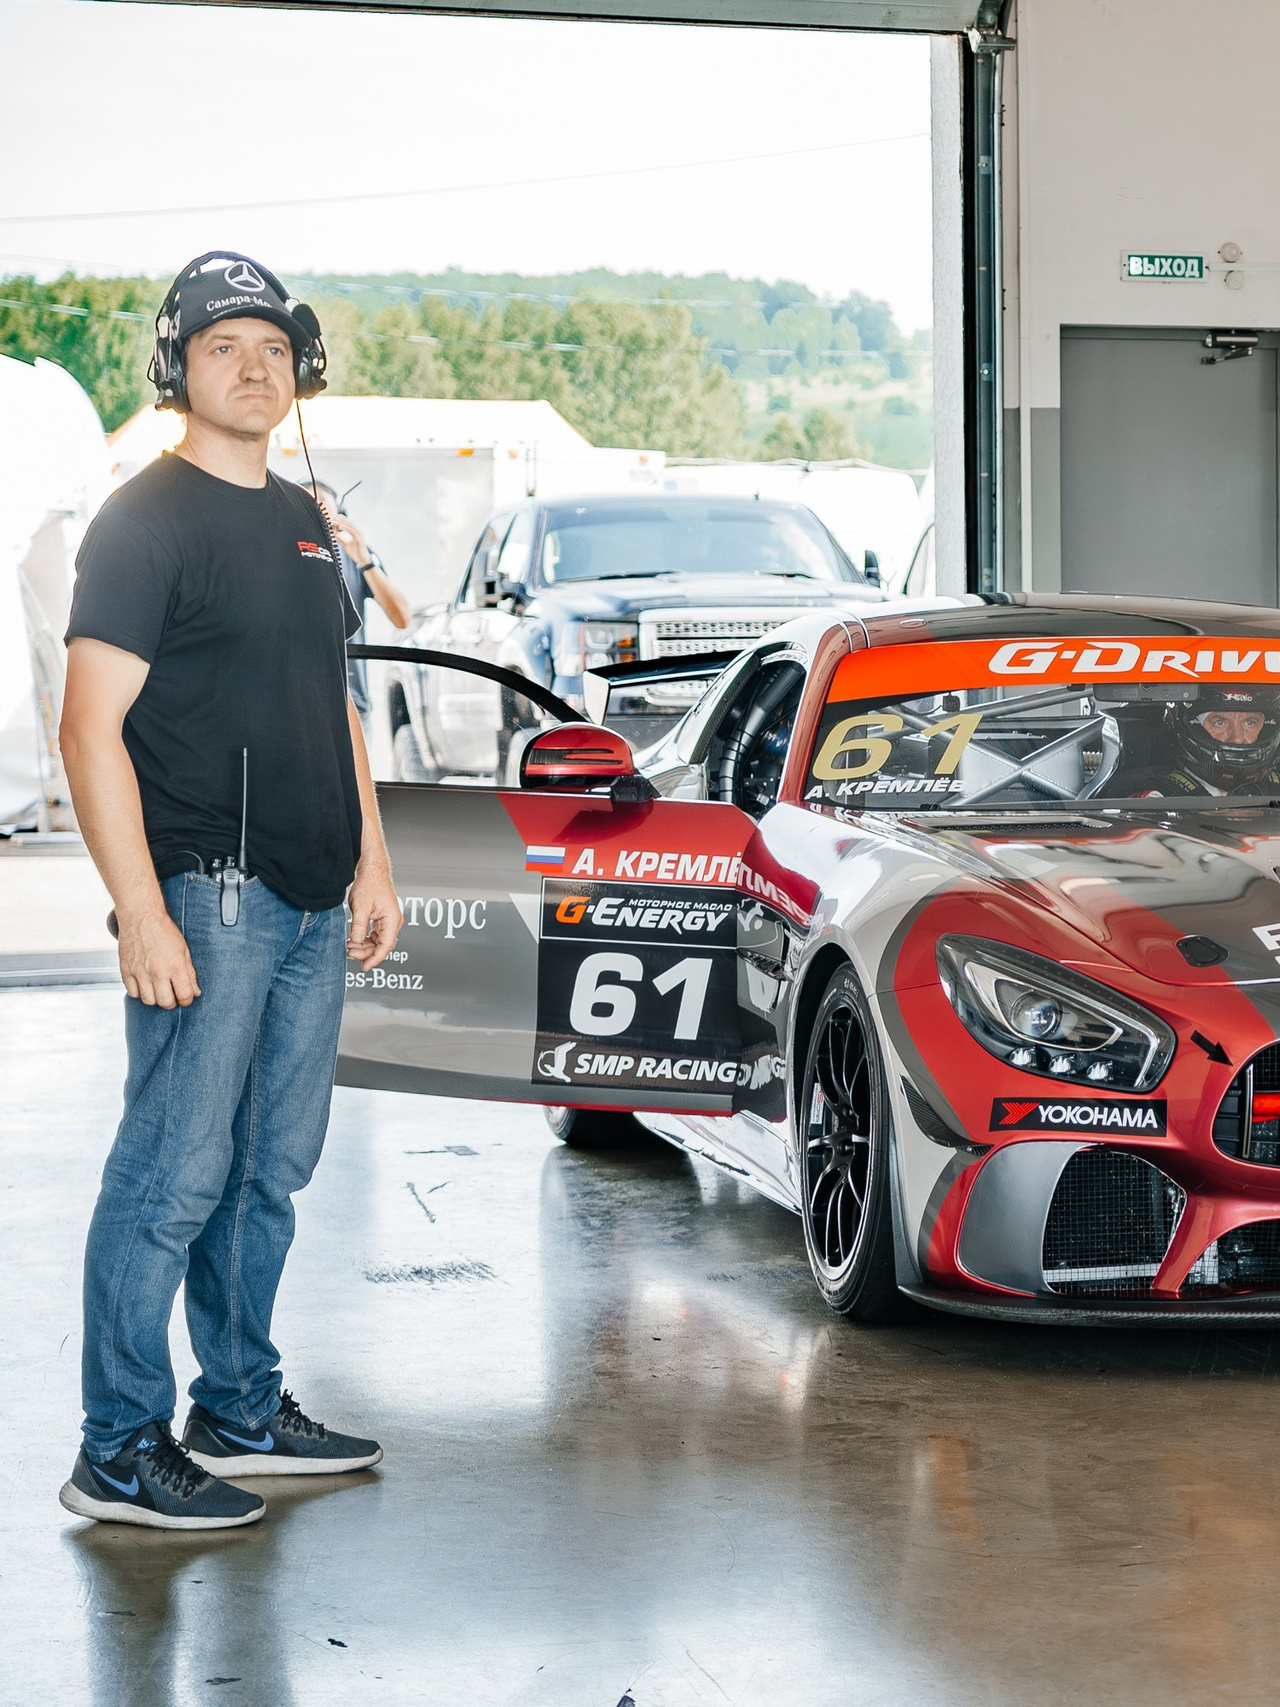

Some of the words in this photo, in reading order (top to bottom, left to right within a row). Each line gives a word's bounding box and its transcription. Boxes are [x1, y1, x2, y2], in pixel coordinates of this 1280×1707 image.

[1129, 256, 1200, 278] ВЫХОД
[206, 295, 272, 312] Самара-Мо
[812, 713, 984, 781] 61
[836, 777, 968, 797] КРЕМЛЁВ
[571, 848, 604, 876] А.
[628, 898, 692, 910] МОТОРНОЕ
[694, 903, 733, 912] МАСЛО
[569, 952, 713, 1041] 61
[574, 1053, 635, 1077] SMP
[636, 1056, 738, 1083] RACING
[1038, 1105, 1159, 1129] YOKOHAMA
